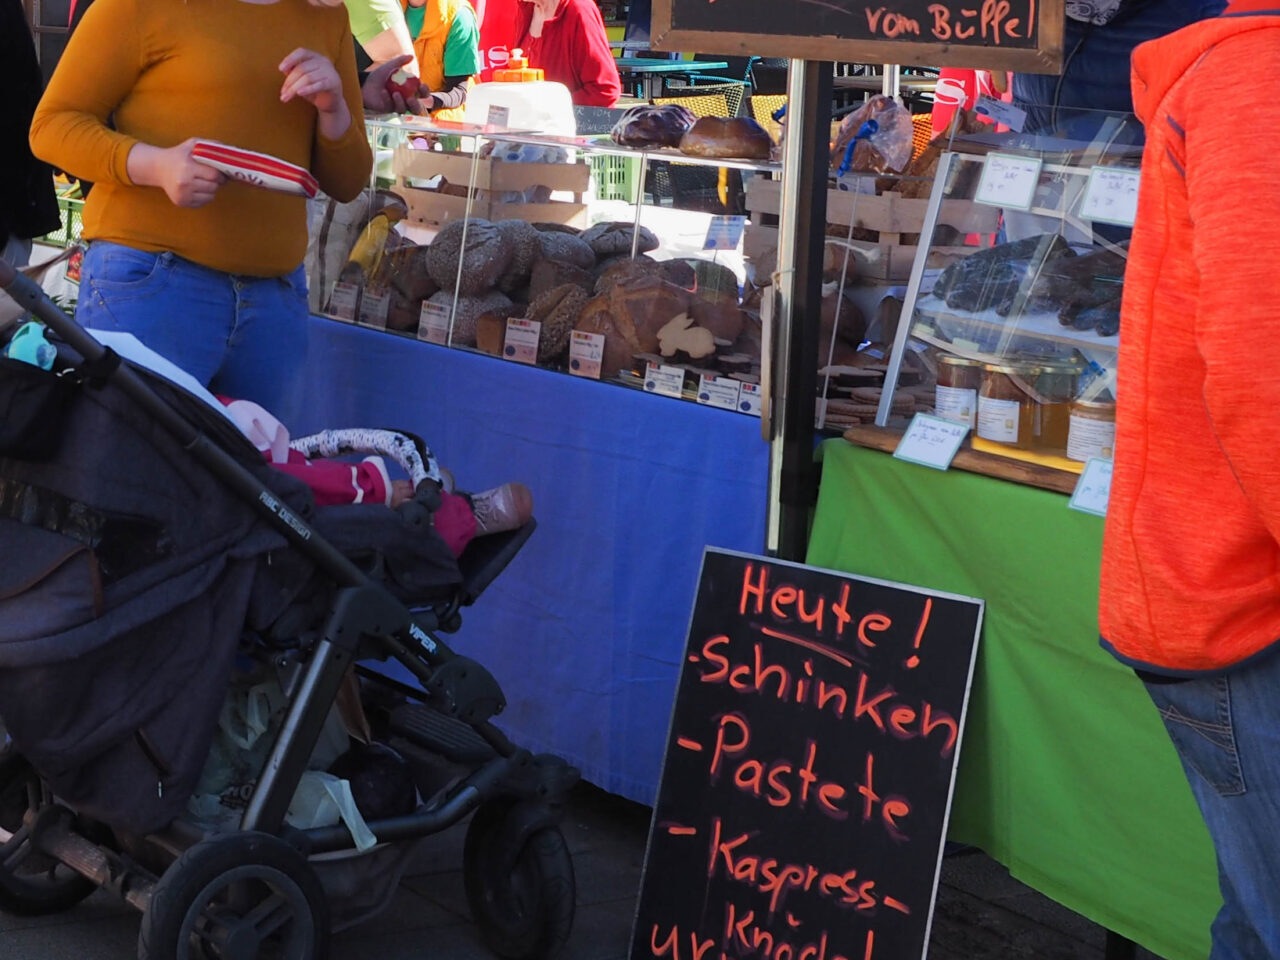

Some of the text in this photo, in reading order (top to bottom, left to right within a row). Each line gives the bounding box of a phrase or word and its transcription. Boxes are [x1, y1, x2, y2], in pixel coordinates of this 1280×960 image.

[739, 562, 893, 648] Heute
[710, 713, 912, 835] Pastete
[726, 903, 876, 960] Knödl
